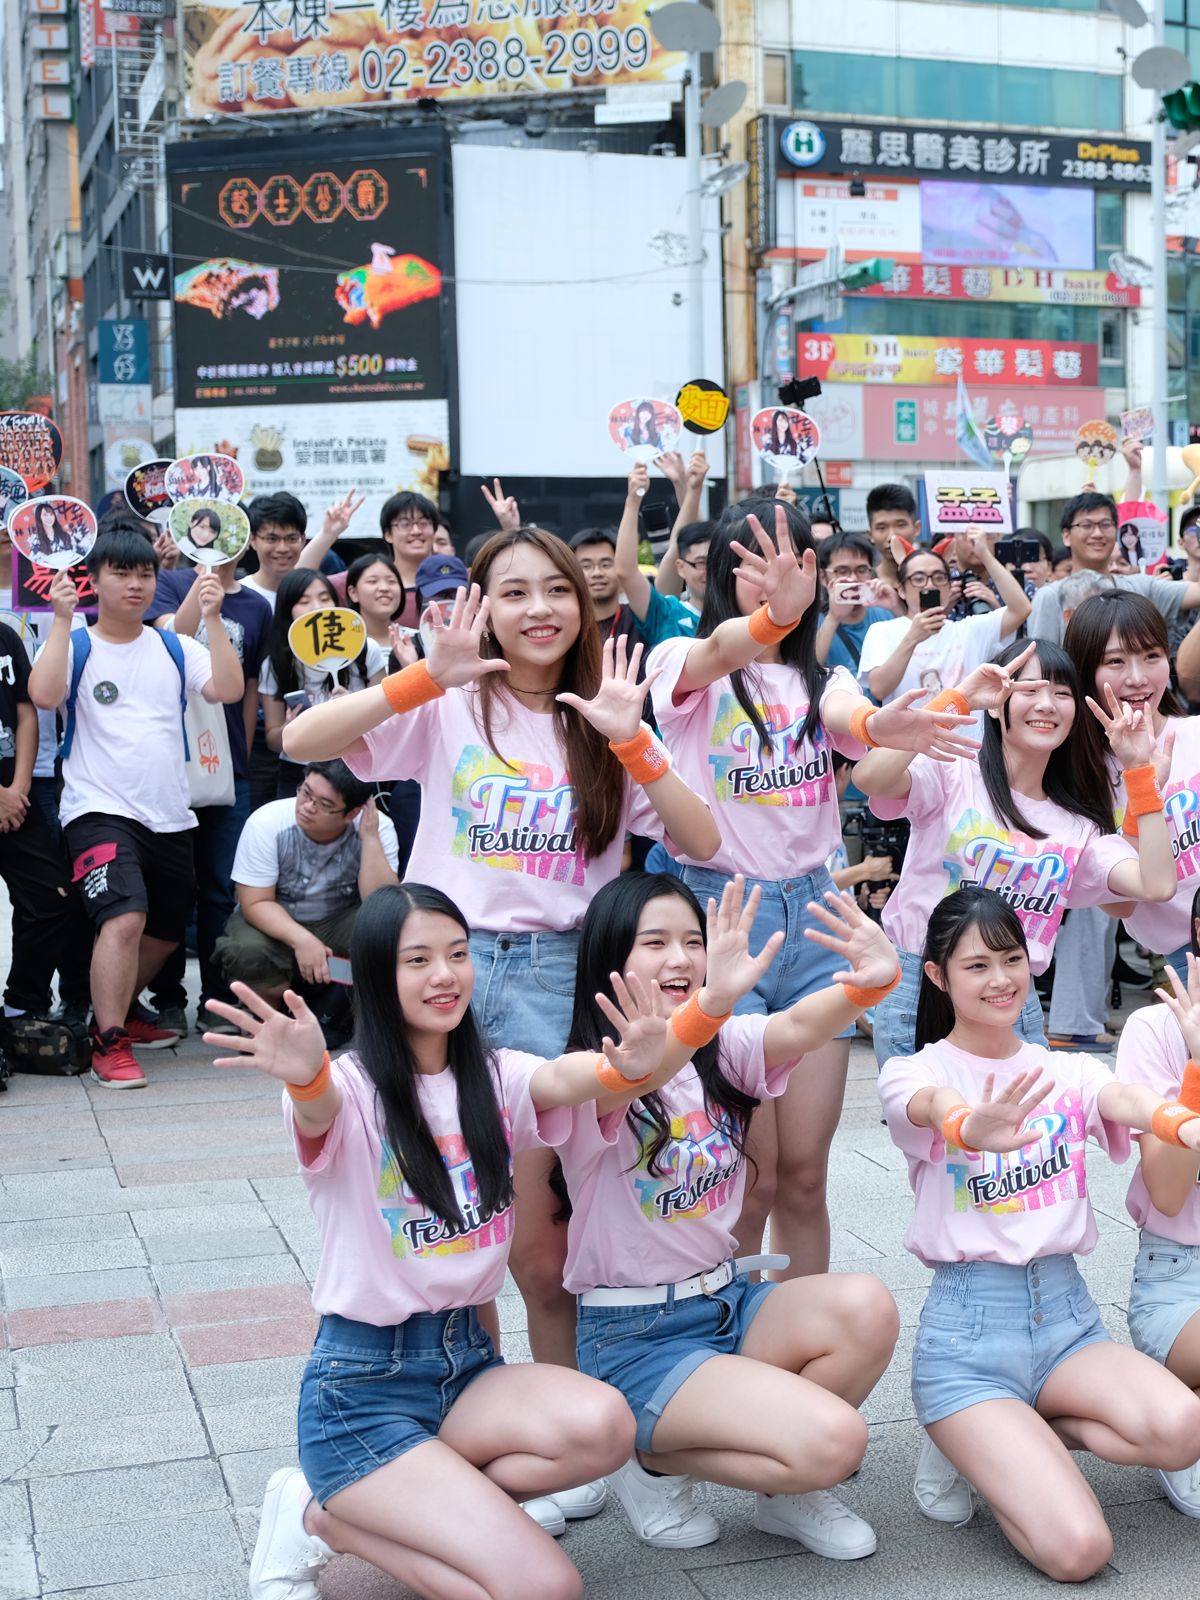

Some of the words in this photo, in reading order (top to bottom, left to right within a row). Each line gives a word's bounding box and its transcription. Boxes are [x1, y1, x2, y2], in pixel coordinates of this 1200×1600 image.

[219, 55, 350, 101] 訂餐專線
[360, 26, 650, 91] 02-2388-2999
[839, 128, 1051, 176] 麗思醫美診所
[1077, 142, 1140, 163] DrPlus
[132, 266, 165, 290] W
[880, 265, 993, 298] 華髮藝
[335, 353, 384, 379] $500
[804, 340, 836, 361] 3F
[347, 437, 388, 447] Potato
[727, 749, 828, 797] Festival
[964, 836, 1068, 896] TTP
[654, 1158, 741, 1220] Festiva
[966, 1141, 1071, 1206] Festival
